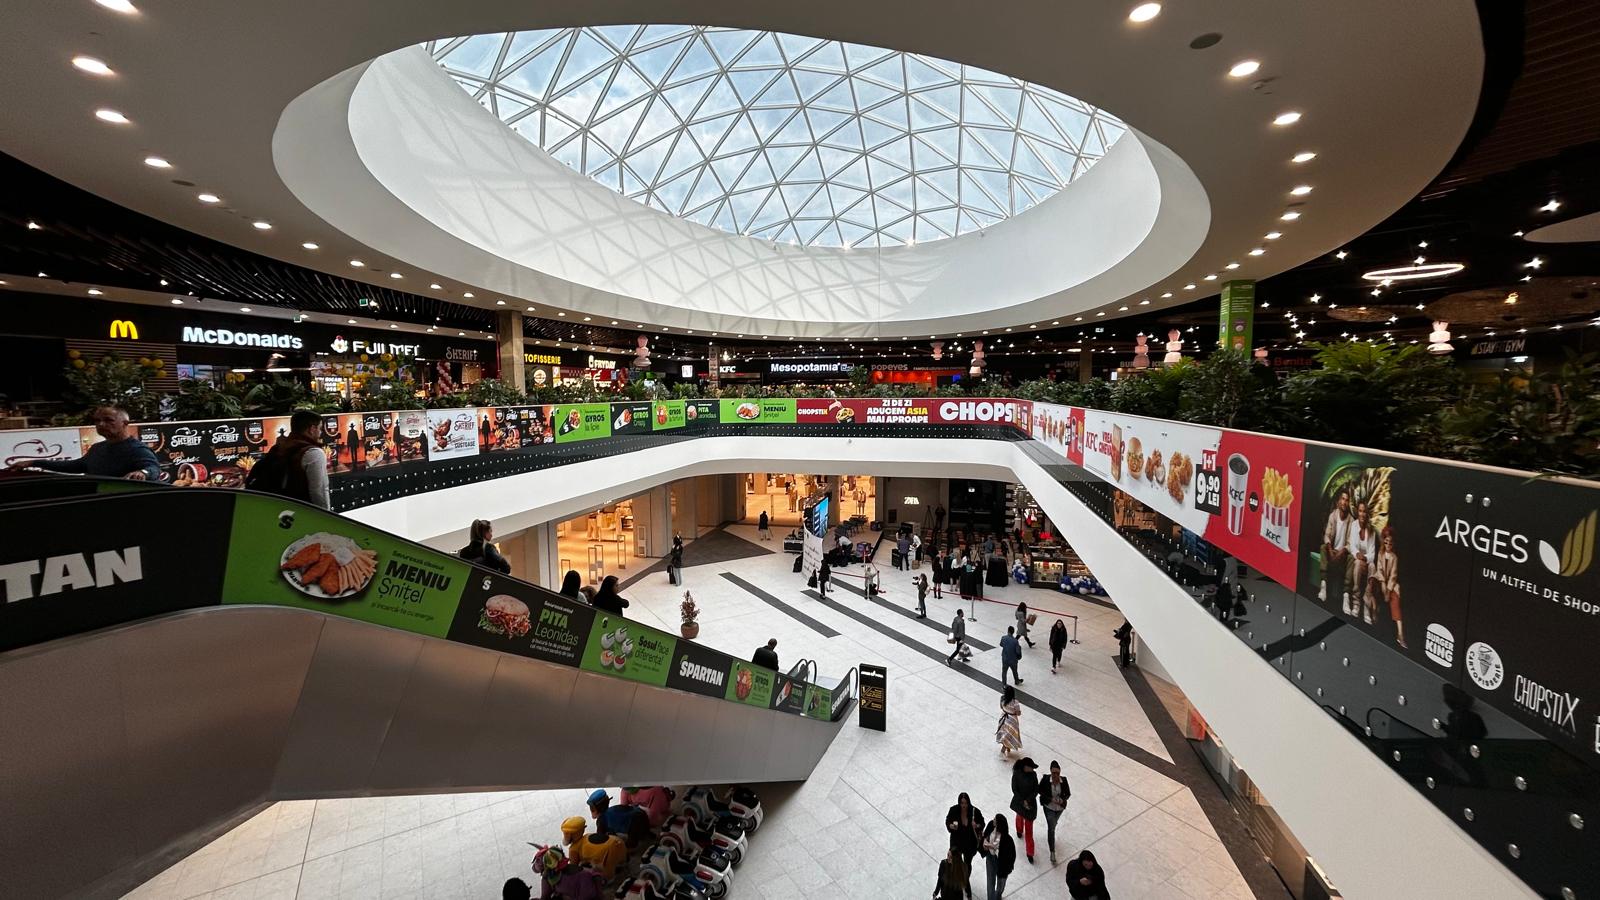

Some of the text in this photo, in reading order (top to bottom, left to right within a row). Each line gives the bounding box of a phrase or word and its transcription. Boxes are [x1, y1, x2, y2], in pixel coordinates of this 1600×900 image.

[183, 327, 302, 349] McDonald's
[1504, 338, 1527, 353] GYM
[446, 346, 477, 361] SHERIFF
[770, 362, 838, 373] Mesopotamia
[585, 414, 605, 422] GYROS
[867, 407, 928, 415] ADUCEM ASIA
[170, 434, 202, 448] SHERIFF
[211, 432, 240, 444] SHERIFF
[1085, 431, 1098, 452] KFC
[1203, 453, 1216, 471] 1+1
[1208, 491, 1219, 507] LEI
[1230, 486, 1245, 502] KFC
[1265, 528, 1281, 544] KFC
[1435, 515, 1528, 563] ARGES
[384, 559, 452, 592] MENIU
[1482, 567, 1497, 580] UN
[1500, 574, 1539, 594] ALTFEL
[1543, 588, 1560, 602] DE
[378, 577, 426, 605] Șnițel
[540, 607, 569, 629] PITA
[534, 622, 579, 646] Leonidas
[638, 635, 657, 651] Sosul
[1426, 630, 1453, 652] BURGER
[1425, 640, 1454, 663] KING
[680, 660, 724, 686] SPARTAN
[1514, 674, 1580, 734] CHOPSTIX
